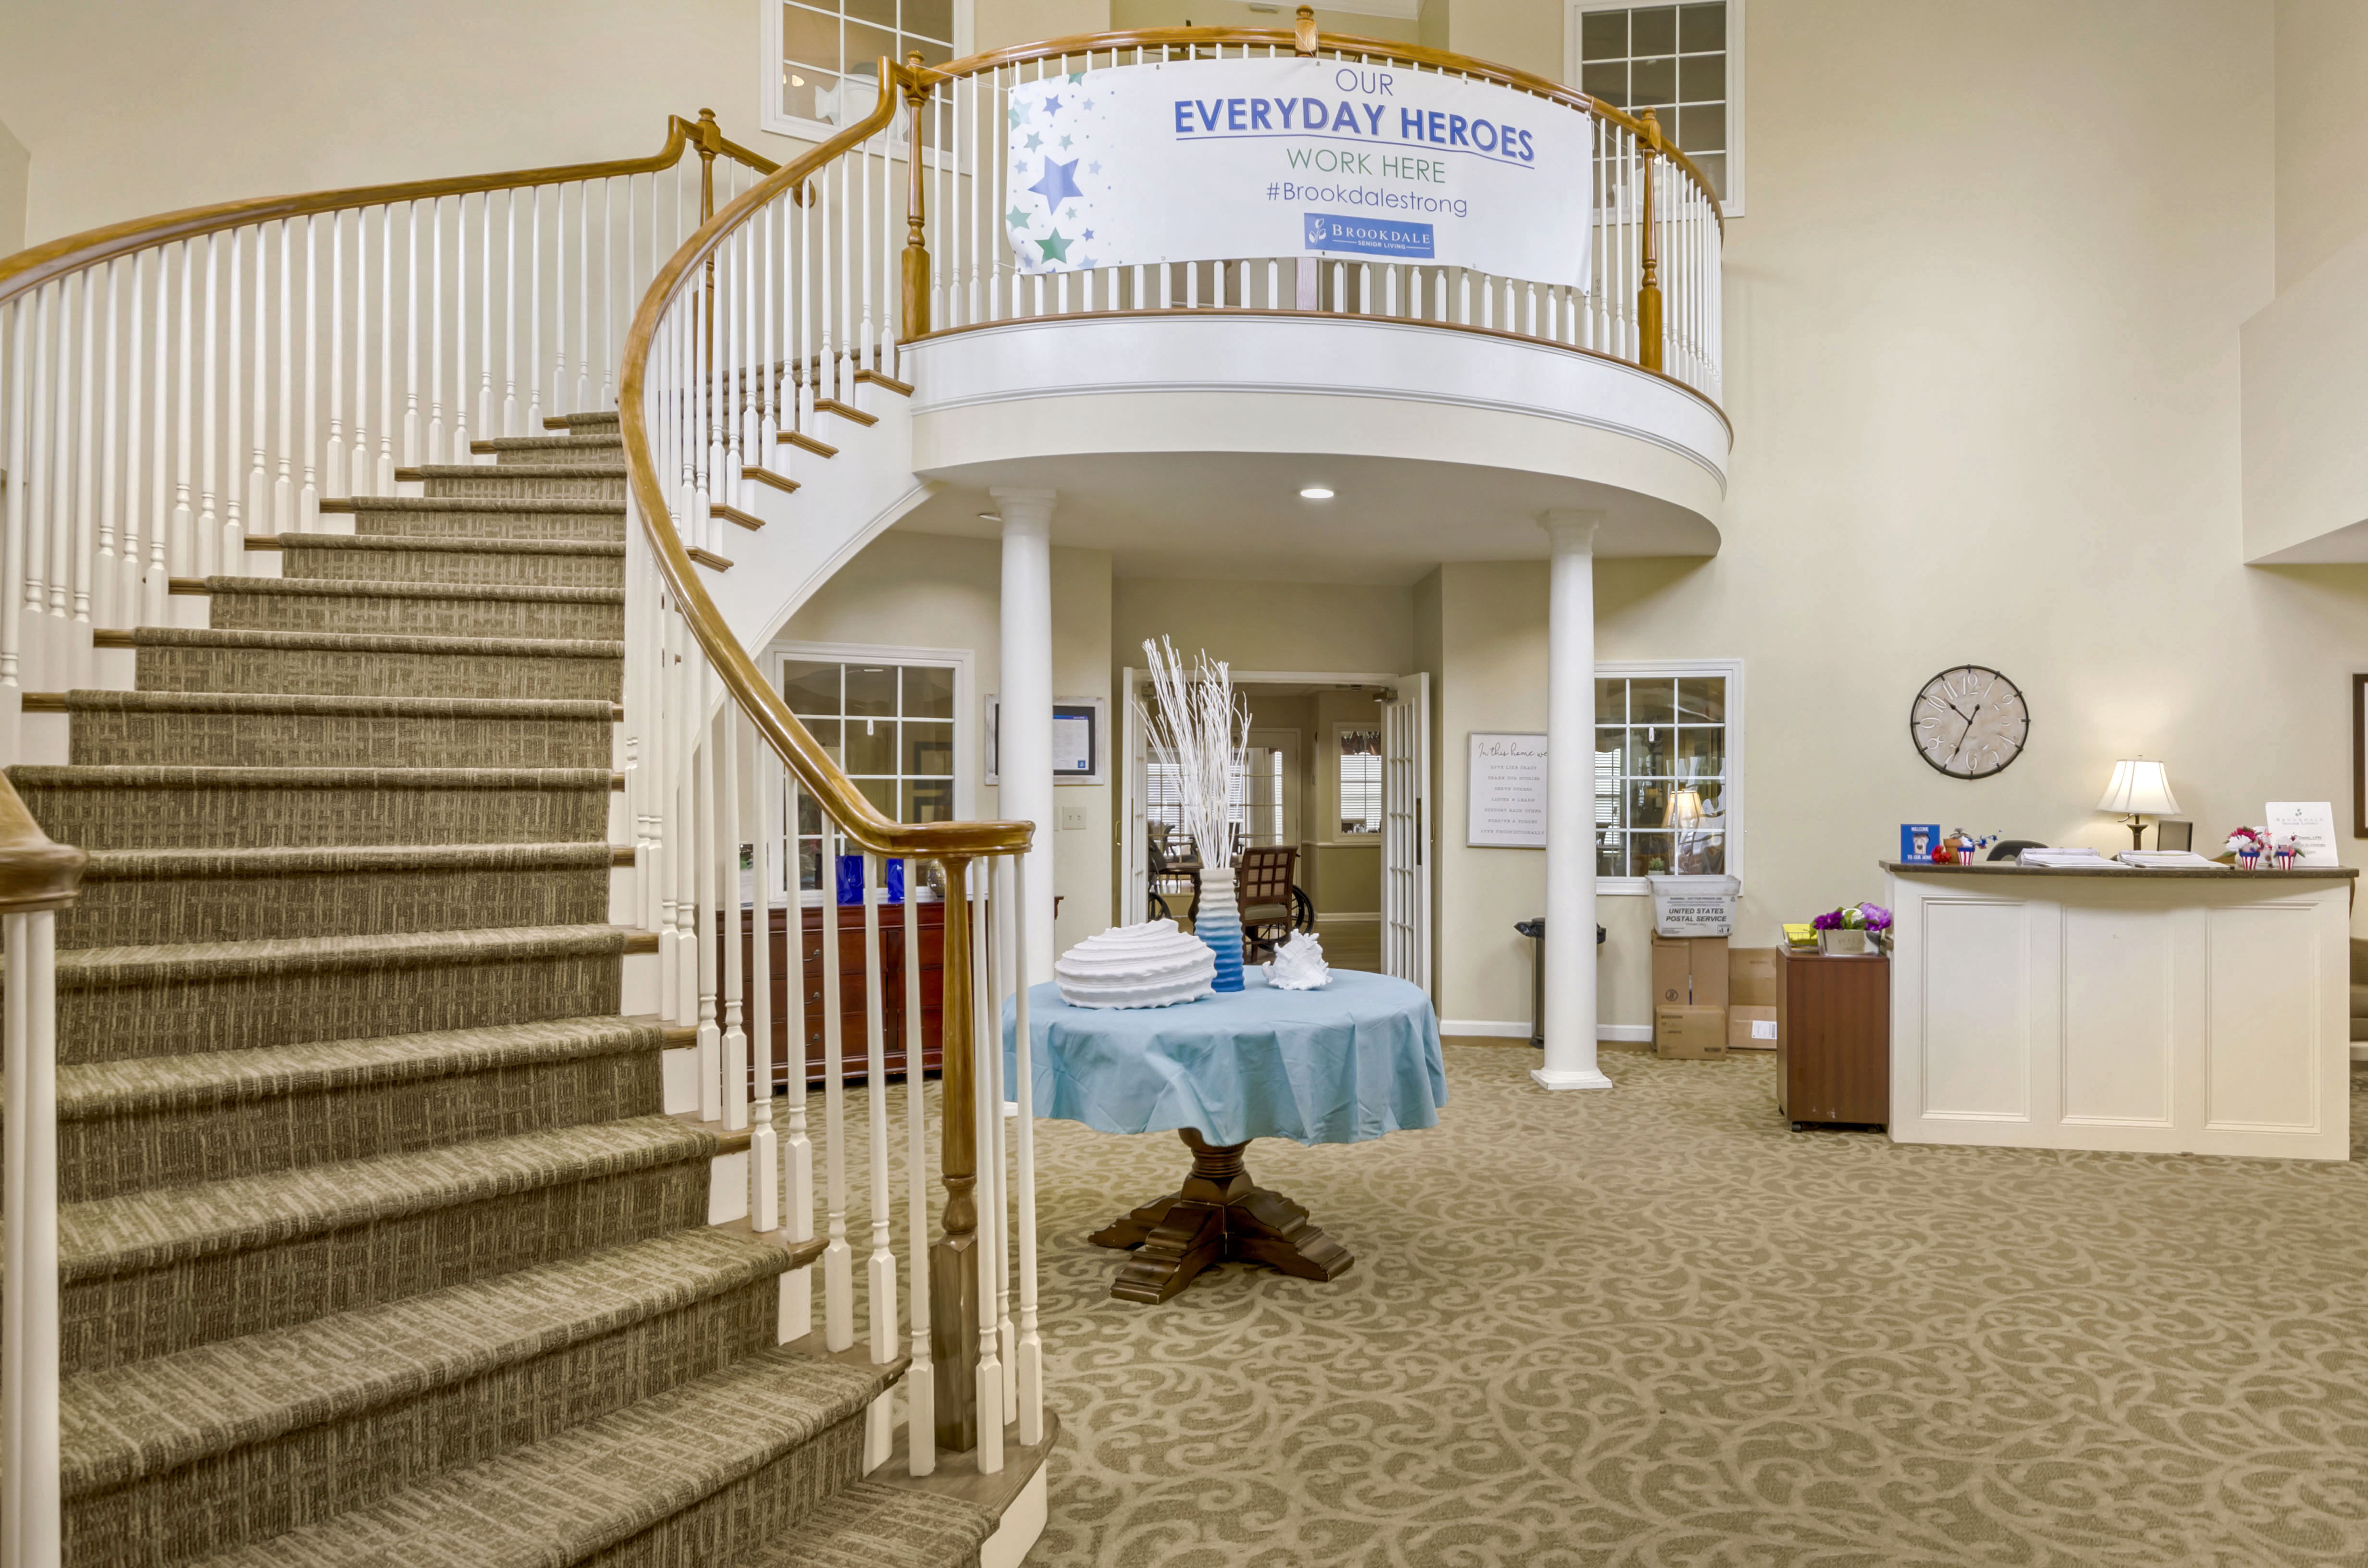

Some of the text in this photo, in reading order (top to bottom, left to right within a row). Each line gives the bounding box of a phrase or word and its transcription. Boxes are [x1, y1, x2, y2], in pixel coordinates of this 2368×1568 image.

[1336, 69, 1393, 96] OUR
[1175, 97, 1535, 162] EVERYDAY HEROES
[1287, 148, 1445, 183] WORK HERE
[1266, 182, 1467, 218] #Brookdalestrong
[1332, 224, 1431, 244] BROOKDALE
[1489, 742, 1509, 757] this
[1511, 742, 1534, 757] home
